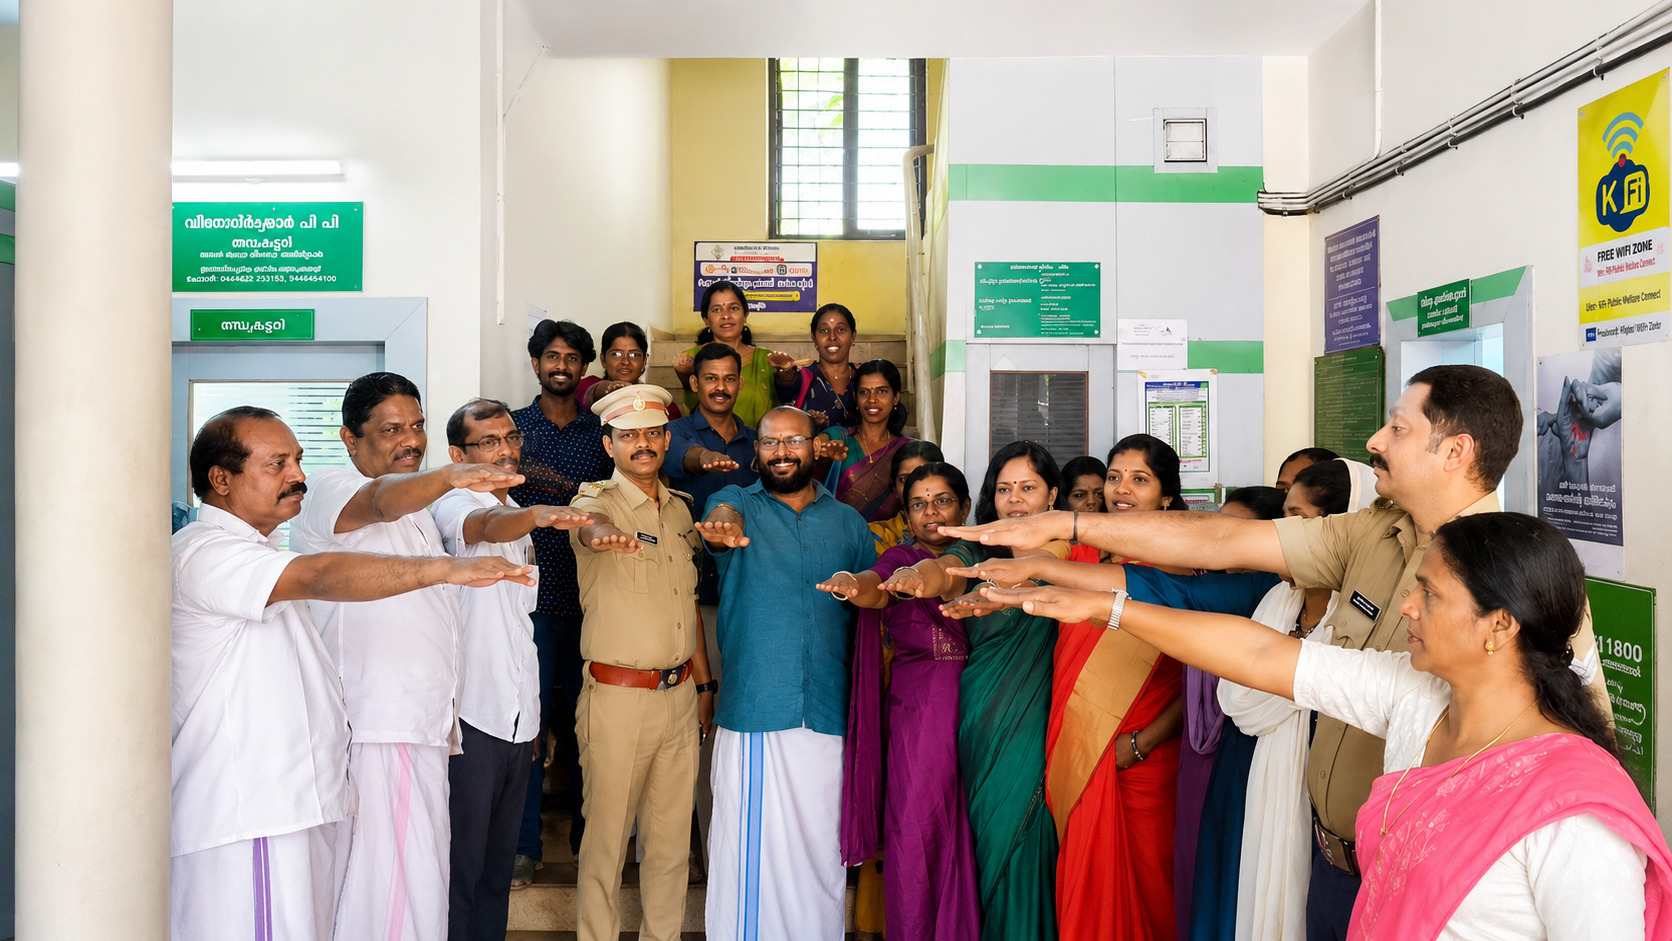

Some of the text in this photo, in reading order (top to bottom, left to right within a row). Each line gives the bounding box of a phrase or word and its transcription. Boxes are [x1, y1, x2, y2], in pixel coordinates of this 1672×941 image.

[1602, 177, 1642, 216] K Fi
[300, 214, 317, 229] പി
[322, 214, 339, 229] പി
[1597, 239, 1653, 263] FREE WIFI ZONE
